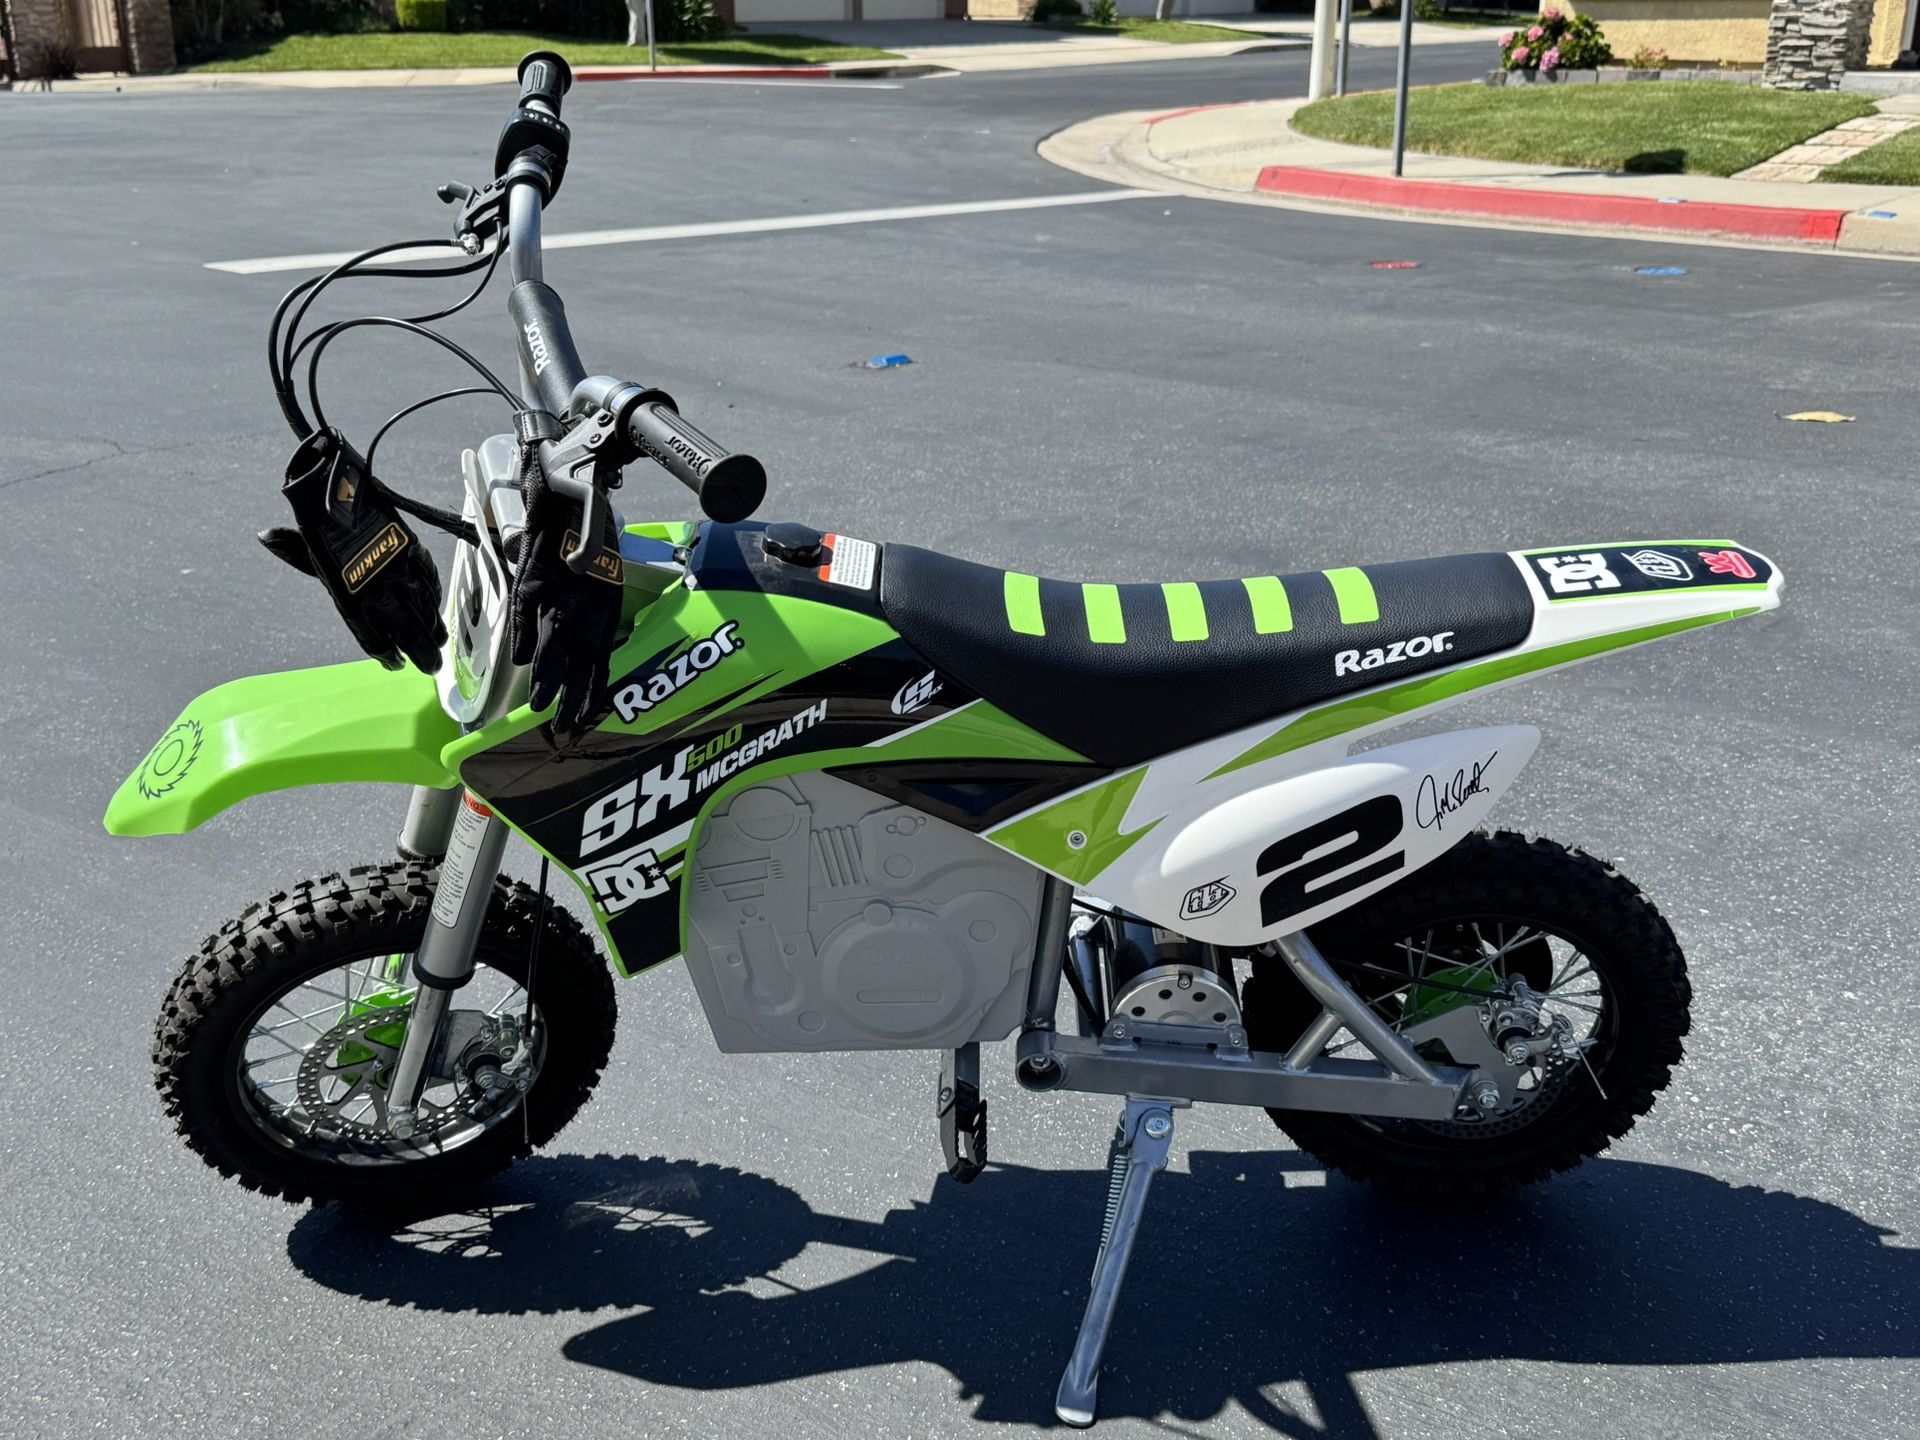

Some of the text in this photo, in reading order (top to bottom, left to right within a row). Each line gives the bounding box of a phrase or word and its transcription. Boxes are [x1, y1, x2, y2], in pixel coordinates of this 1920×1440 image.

[523, 317, 552, 376] Razor
[348, 526, 400, 584] Franklin
[611, 620, 744, 723] Razor
[1334, 631, 1455, 677] Razor
[579, 723, 743, 858] SX 500
[695, 698, 828, 794] MCGRATH
[1256, 794, 1405, 928] 2
